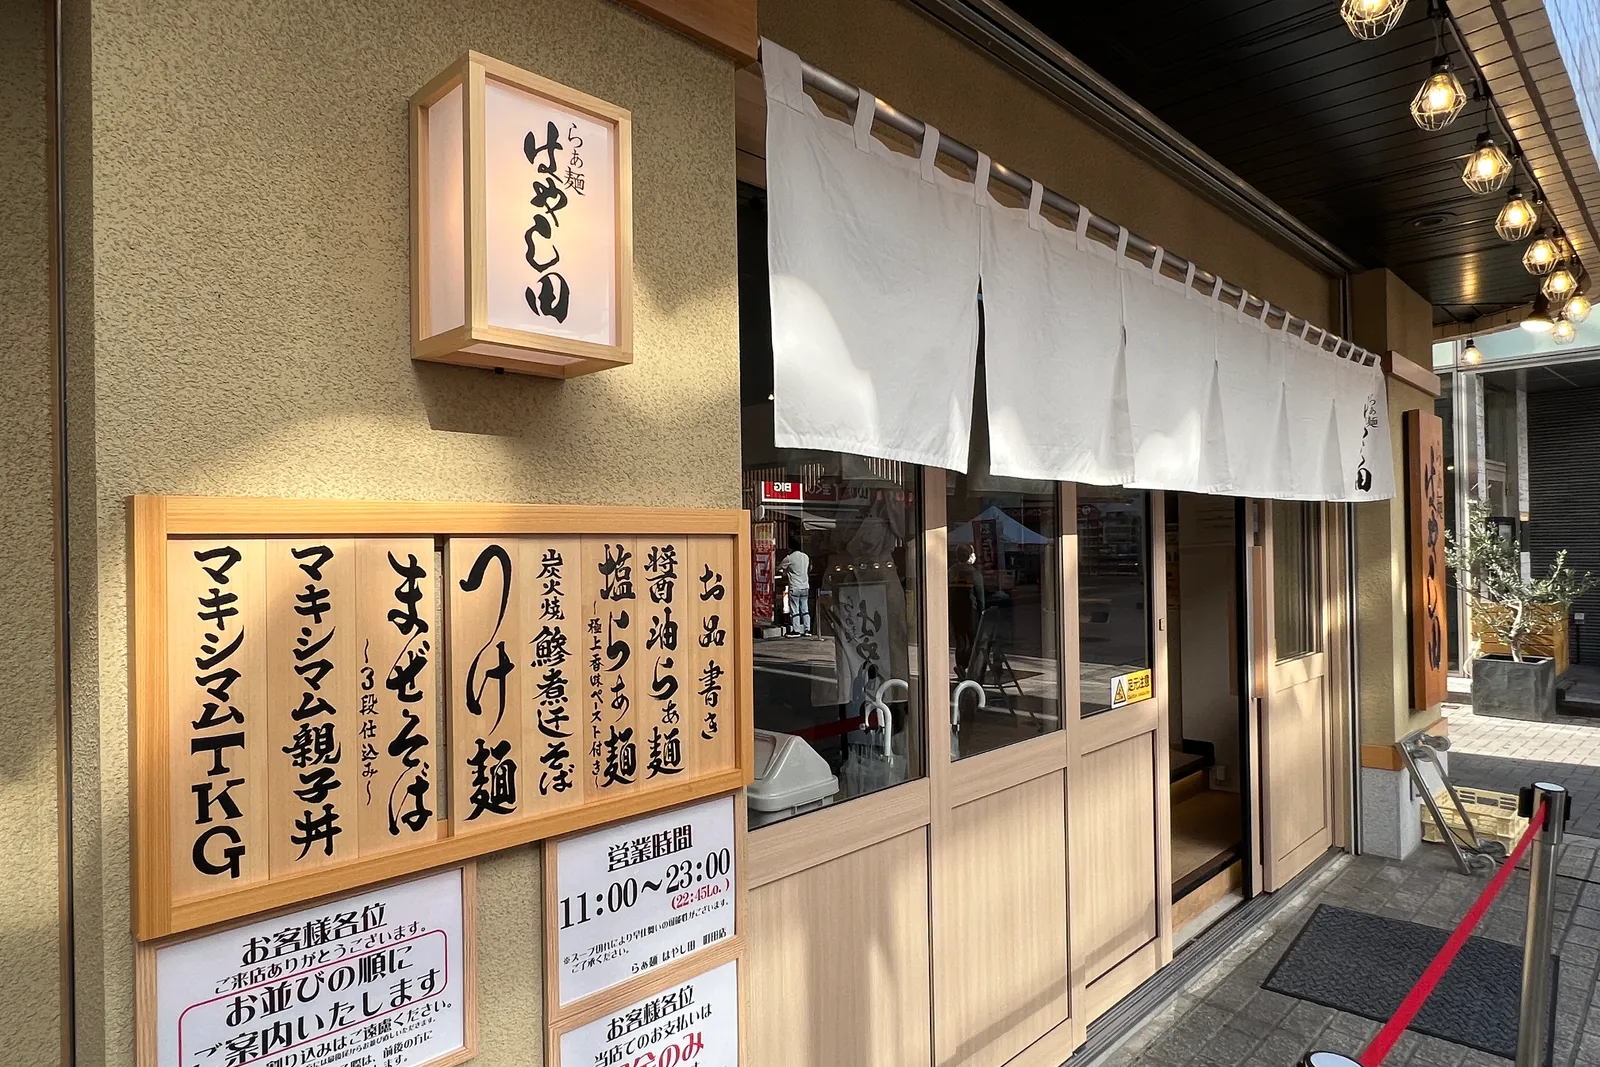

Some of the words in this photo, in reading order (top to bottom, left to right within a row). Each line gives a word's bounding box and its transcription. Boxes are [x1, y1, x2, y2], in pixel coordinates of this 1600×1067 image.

[523, 120, 571, 324] はやし田
[190, 544, 246, 880] マキシマムTKG
[281, 544, 343, 862] マキシマム親子丼
[384, 549, 435, 836] まぜそば
[459, 543, 518, 821] つけ麺
[697, 563, 727, 741] お品書き
[607, 824, 694, 873] 営業時間
[214, 919, 428, 994] ご来店ありがとうございます。
[225, 945, 414, 1027] お並びの順に
[240, 902, 389, 968] お客様各位
[662, 940, 696, 962] はやし田
[606, 984, 695, 1042] お客様各位
